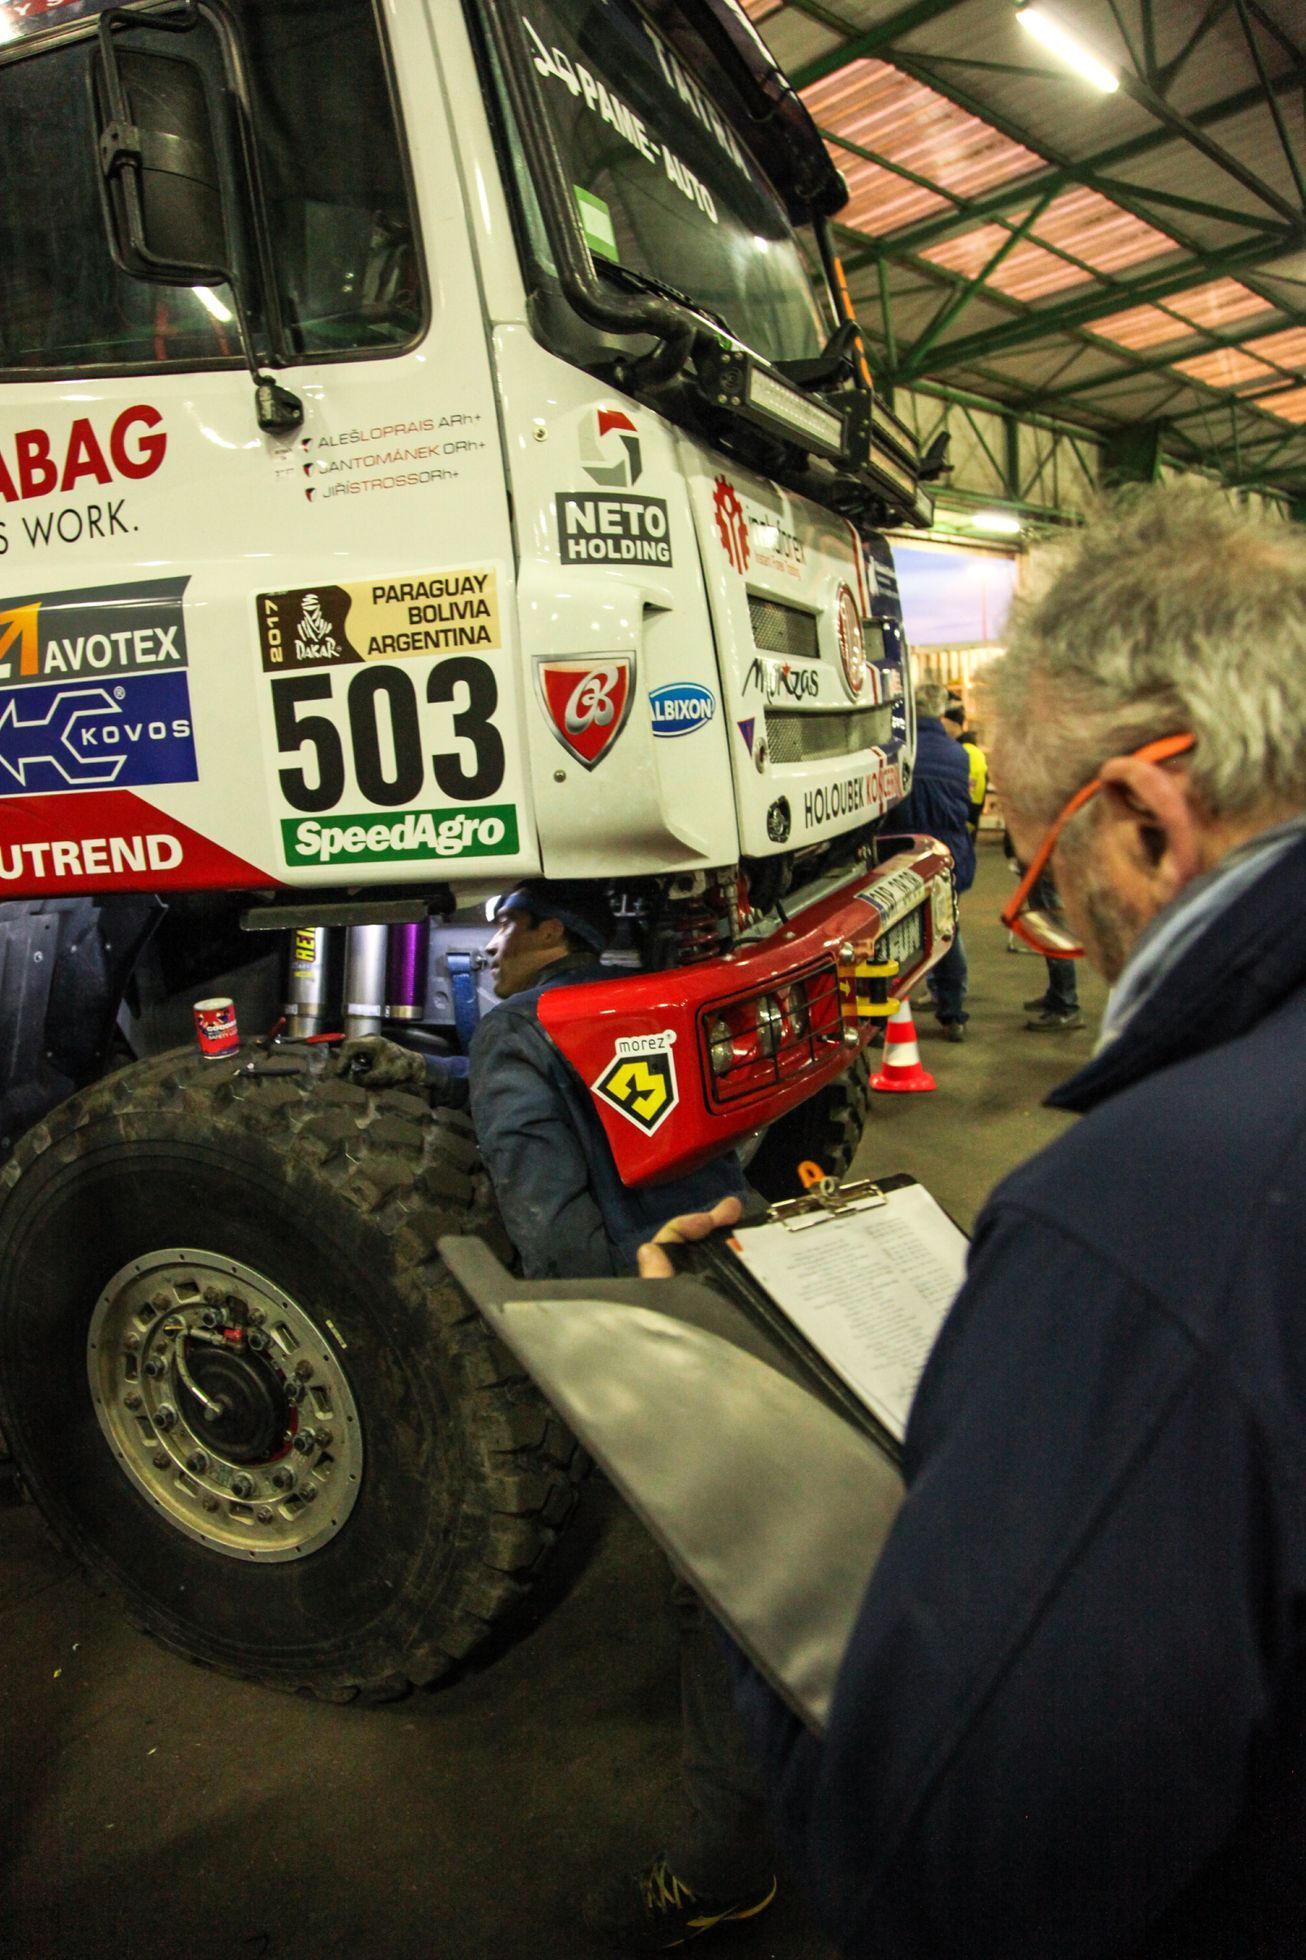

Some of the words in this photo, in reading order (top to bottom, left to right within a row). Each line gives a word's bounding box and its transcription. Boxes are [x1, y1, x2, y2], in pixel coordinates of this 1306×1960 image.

[22, 499, 139, 549] WORK.
[565, 501, 667, 539] NETO
[568, 539, 670, 562] HOLDING
[372, 574, 489, 605] PARAGUAY
[264, 599, 284, 663] 2017
[408, 599, 491, 625] BOLIVIA
[44, 626, 181, 674] AVOTEX
[367, 625, 491, 656] ARGENTINA
[651, 698, 712, 721] LBIXON
[81, 720, 190, 746] KOVOS
[270, 656, 505, 813] 503
[804, 776, 865, 829] HOLOUBEK
[0, 834, 183, 880] UTREND
[295, 814, 505, 862] SpeedAgro
[619, 1037, 666, 1053] morez
